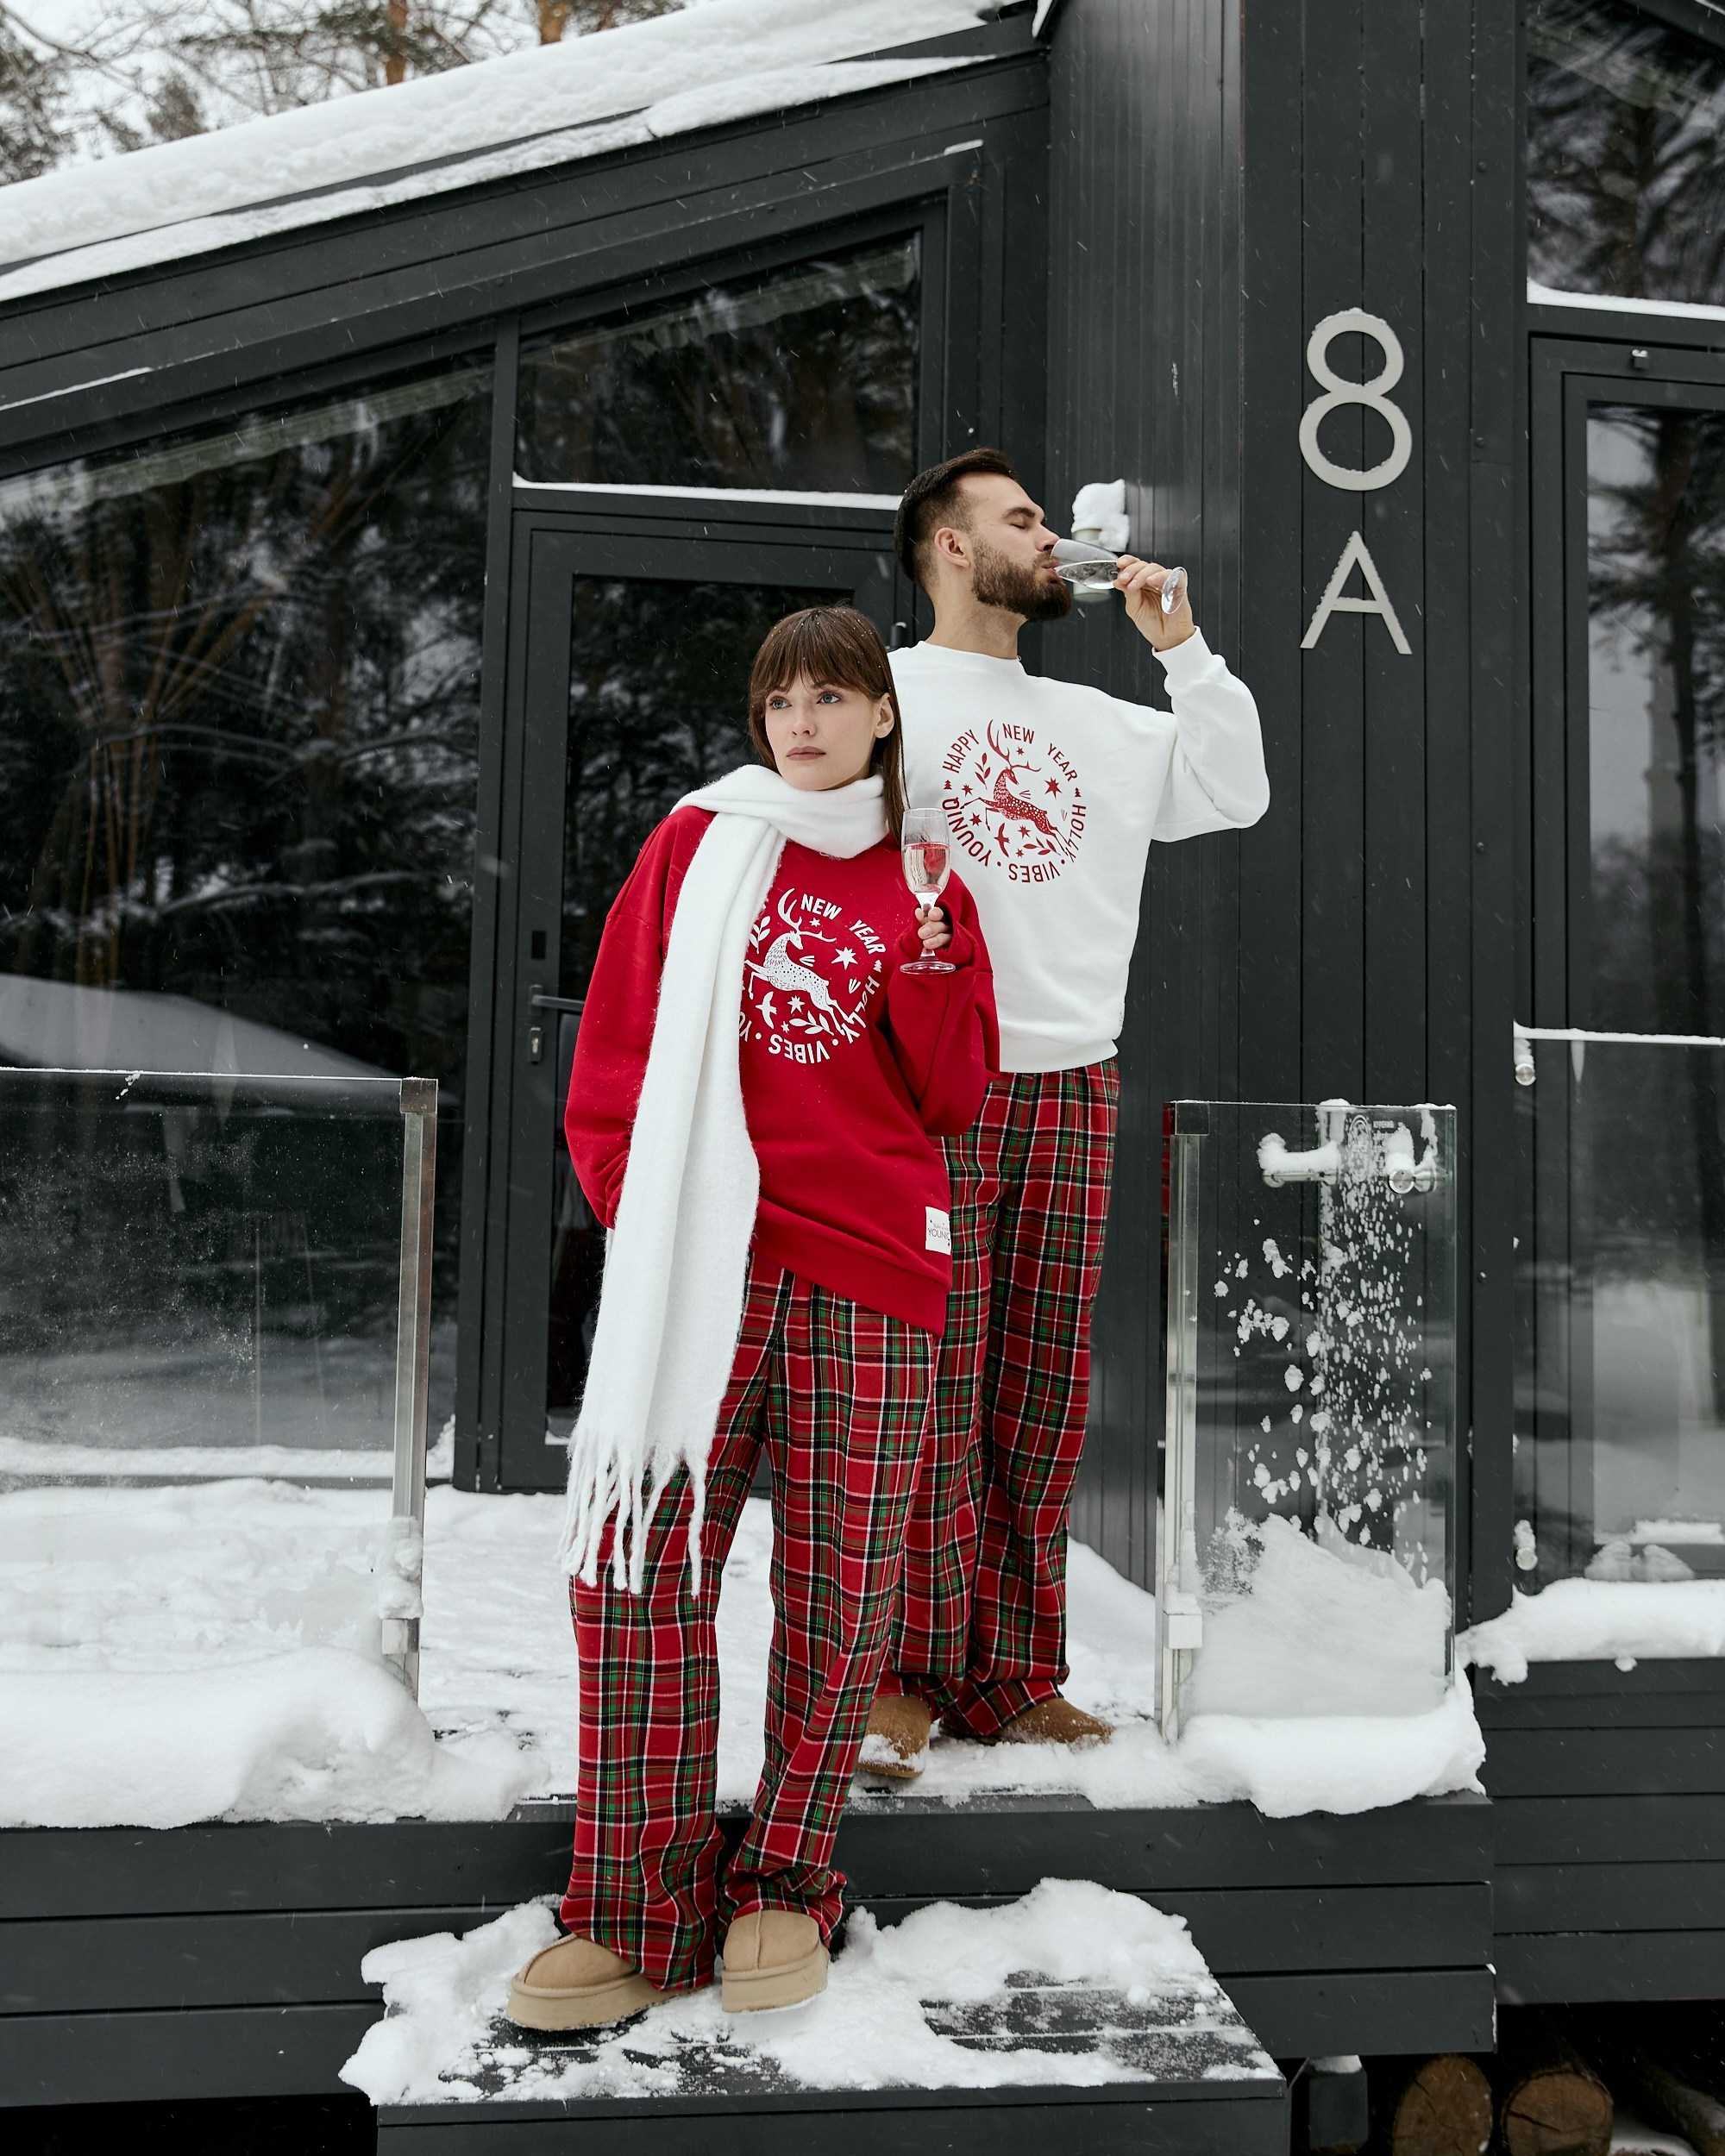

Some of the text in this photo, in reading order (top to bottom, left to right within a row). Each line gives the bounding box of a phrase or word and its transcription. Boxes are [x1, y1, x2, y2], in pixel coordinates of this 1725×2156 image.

[1299, 307, 1413, 491] 8
[1300, 531, 1413, 655] A
[943, 723, 1078, 781] HAPPY NEW YEAR
[942, 797, 1087, 883] HOLLY VIBES YOUNIQ
[800, 893, 886, 954] NEW YEAR
[768, 975, 881, 1064] HOLLY VIBES
